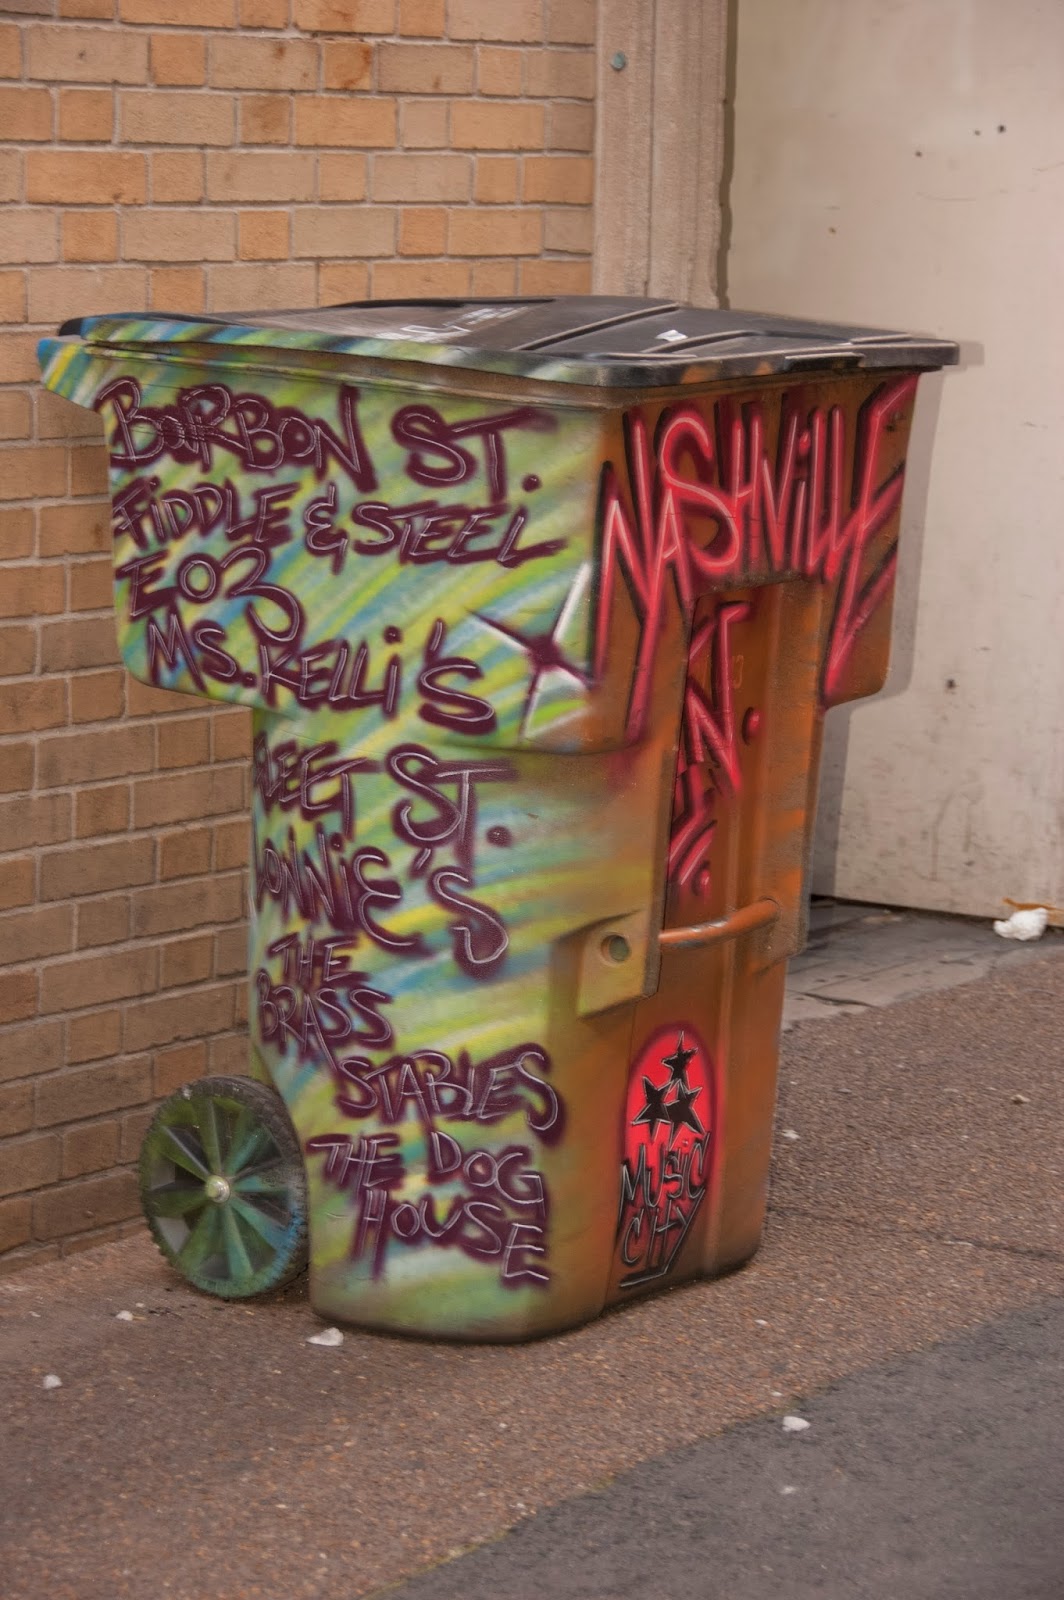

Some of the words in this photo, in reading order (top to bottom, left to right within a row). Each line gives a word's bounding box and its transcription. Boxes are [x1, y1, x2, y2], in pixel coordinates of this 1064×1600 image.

[391, 404, 556, 505] ST.
[303, 478, 348, 574] &
[350, 500, 567, 569] STEEL
[385, 743, 519, 870] ST.
[266, 932, 372, 985] THE
[256, 968, 395, 1074] BRASS
[334, 1042, 566, 1148] STABLES
[304, 1132, 404, 1195] THE
[426, 1128, 547, 1218] DOG
[353, 1186, 552, 1291] HOUSE
